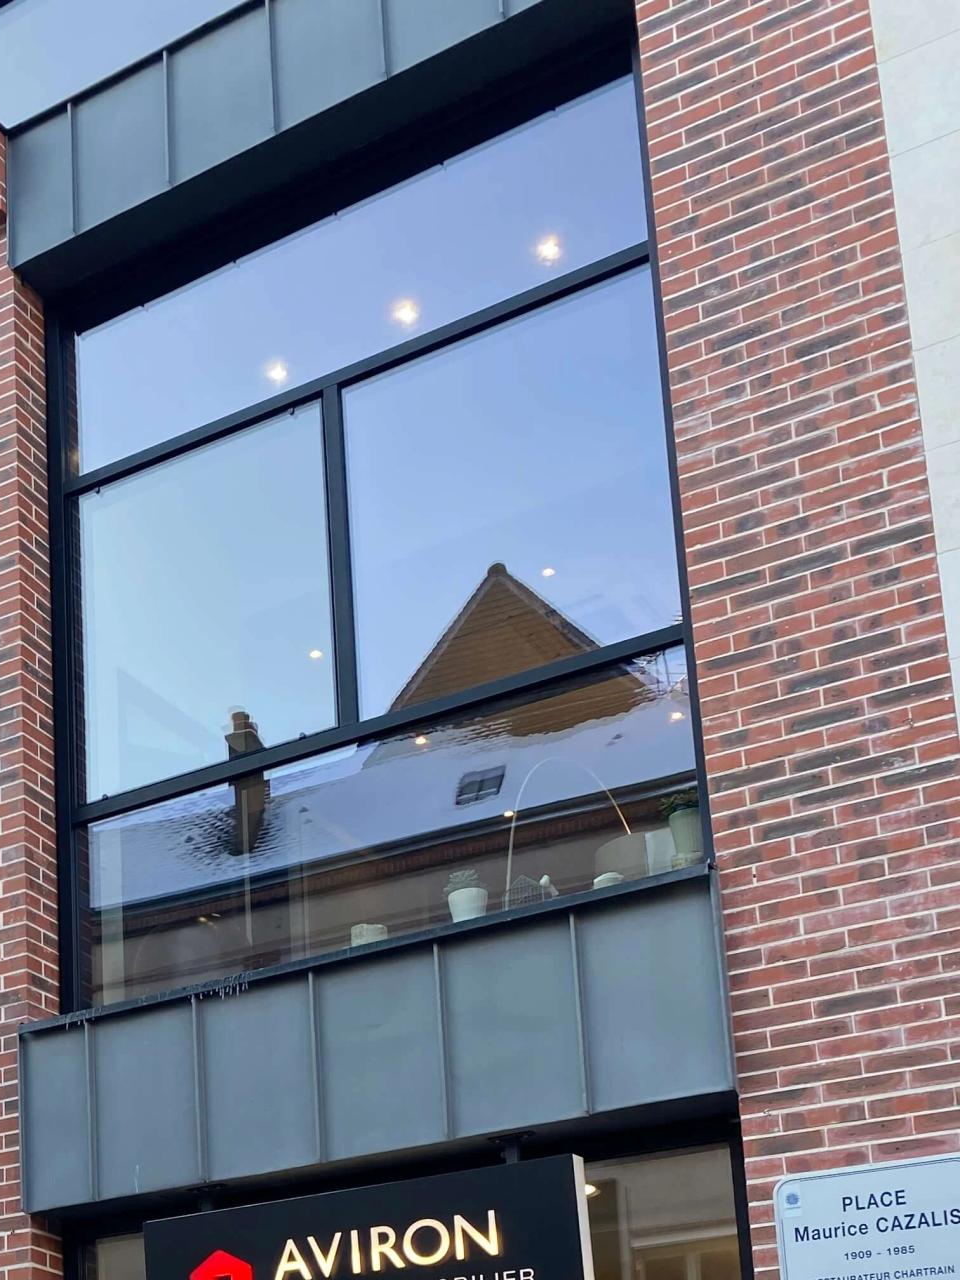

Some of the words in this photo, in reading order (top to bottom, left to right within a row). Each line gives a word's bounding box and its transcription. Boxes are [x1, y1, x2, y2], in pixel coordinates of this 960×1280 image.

[841, 1189, 907, 1212] PLACE
[794, 1221, 869, 1243] Maurice
[875, 1208, 960, 1233] CAZALIS
[843, 1249, 872, 1261] 1909
[886, 1244, 916, 1256] 1985
[893, 1265, 955, 1280] CHARTRAIN
